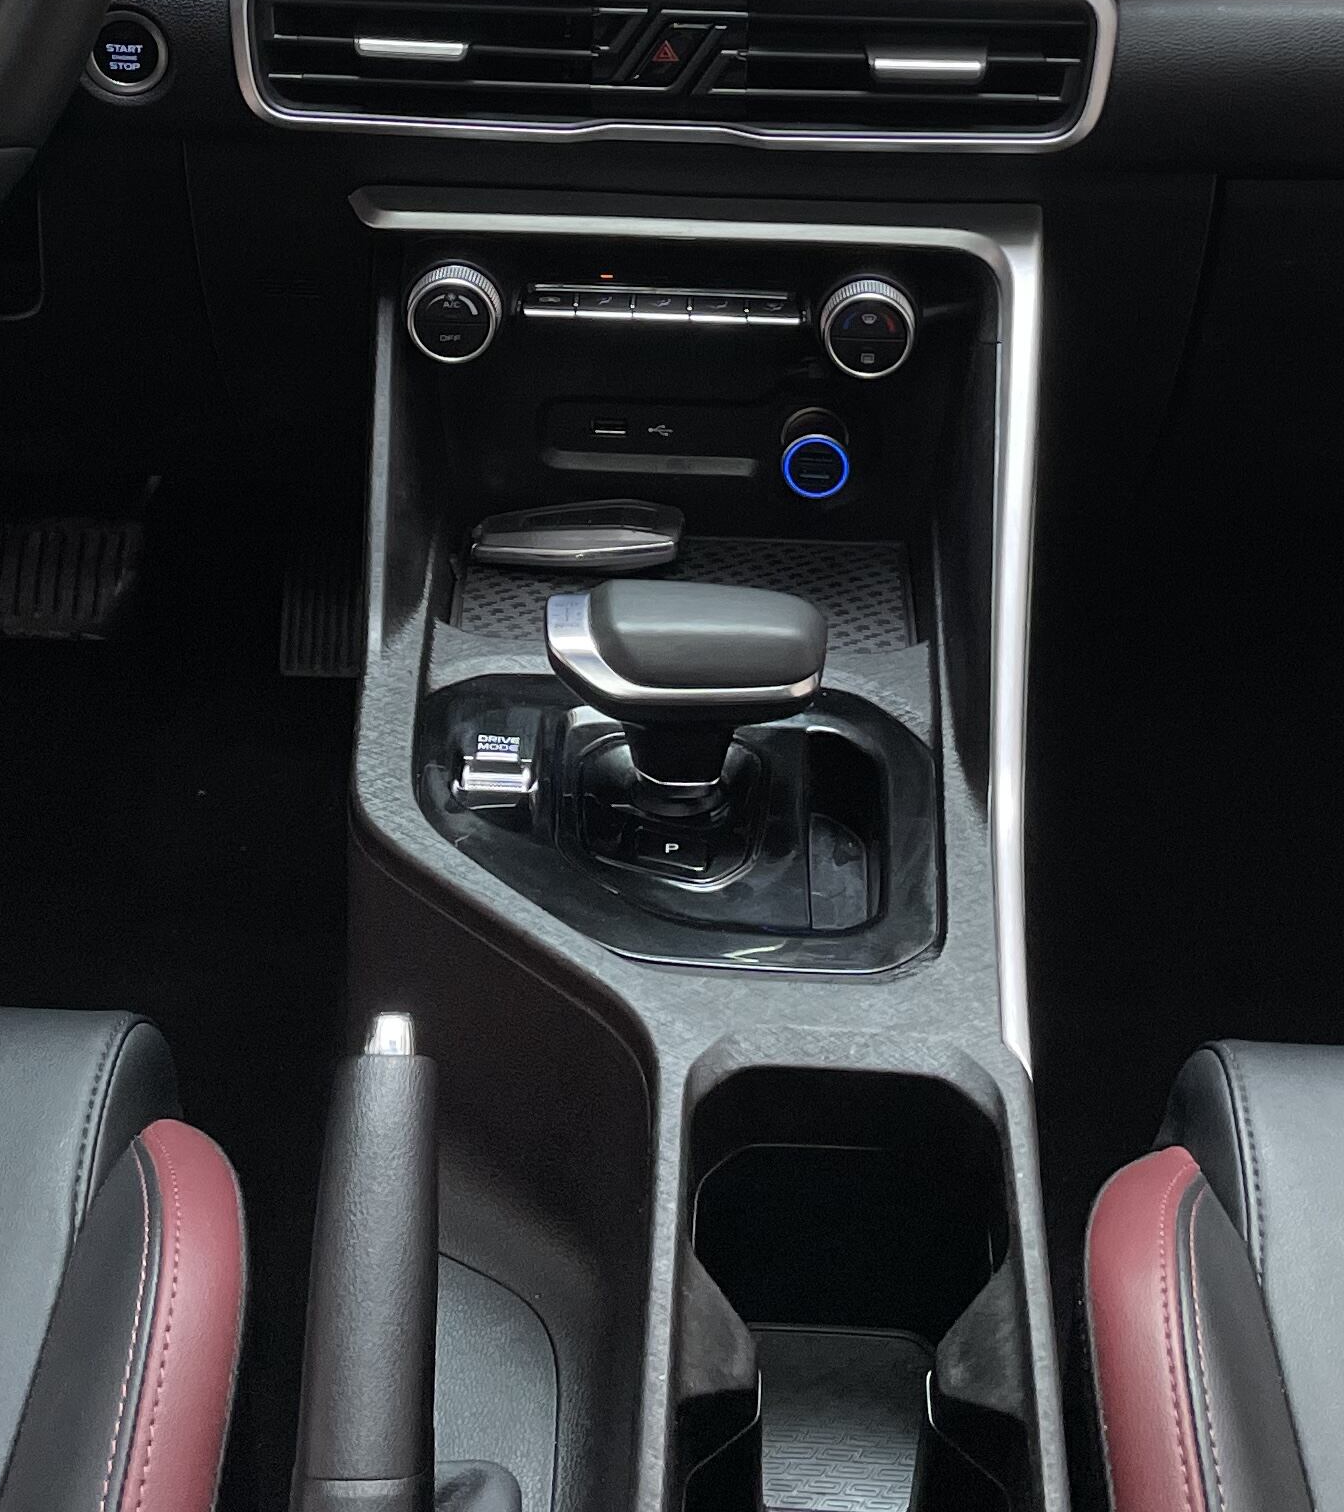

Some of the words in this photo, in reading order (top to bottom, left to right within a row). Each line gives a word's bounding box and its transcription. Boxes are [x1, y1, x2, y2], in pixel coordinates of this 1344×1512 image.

[106, 43, 143, 53] START
[109, 62, 141, 70] STOP
[443, 301, 461, 309] A/C
[478, 734, 520, 744] DRIVE
[477, 743, 519, 752] MODE
[664, 842, 680, 854] P
